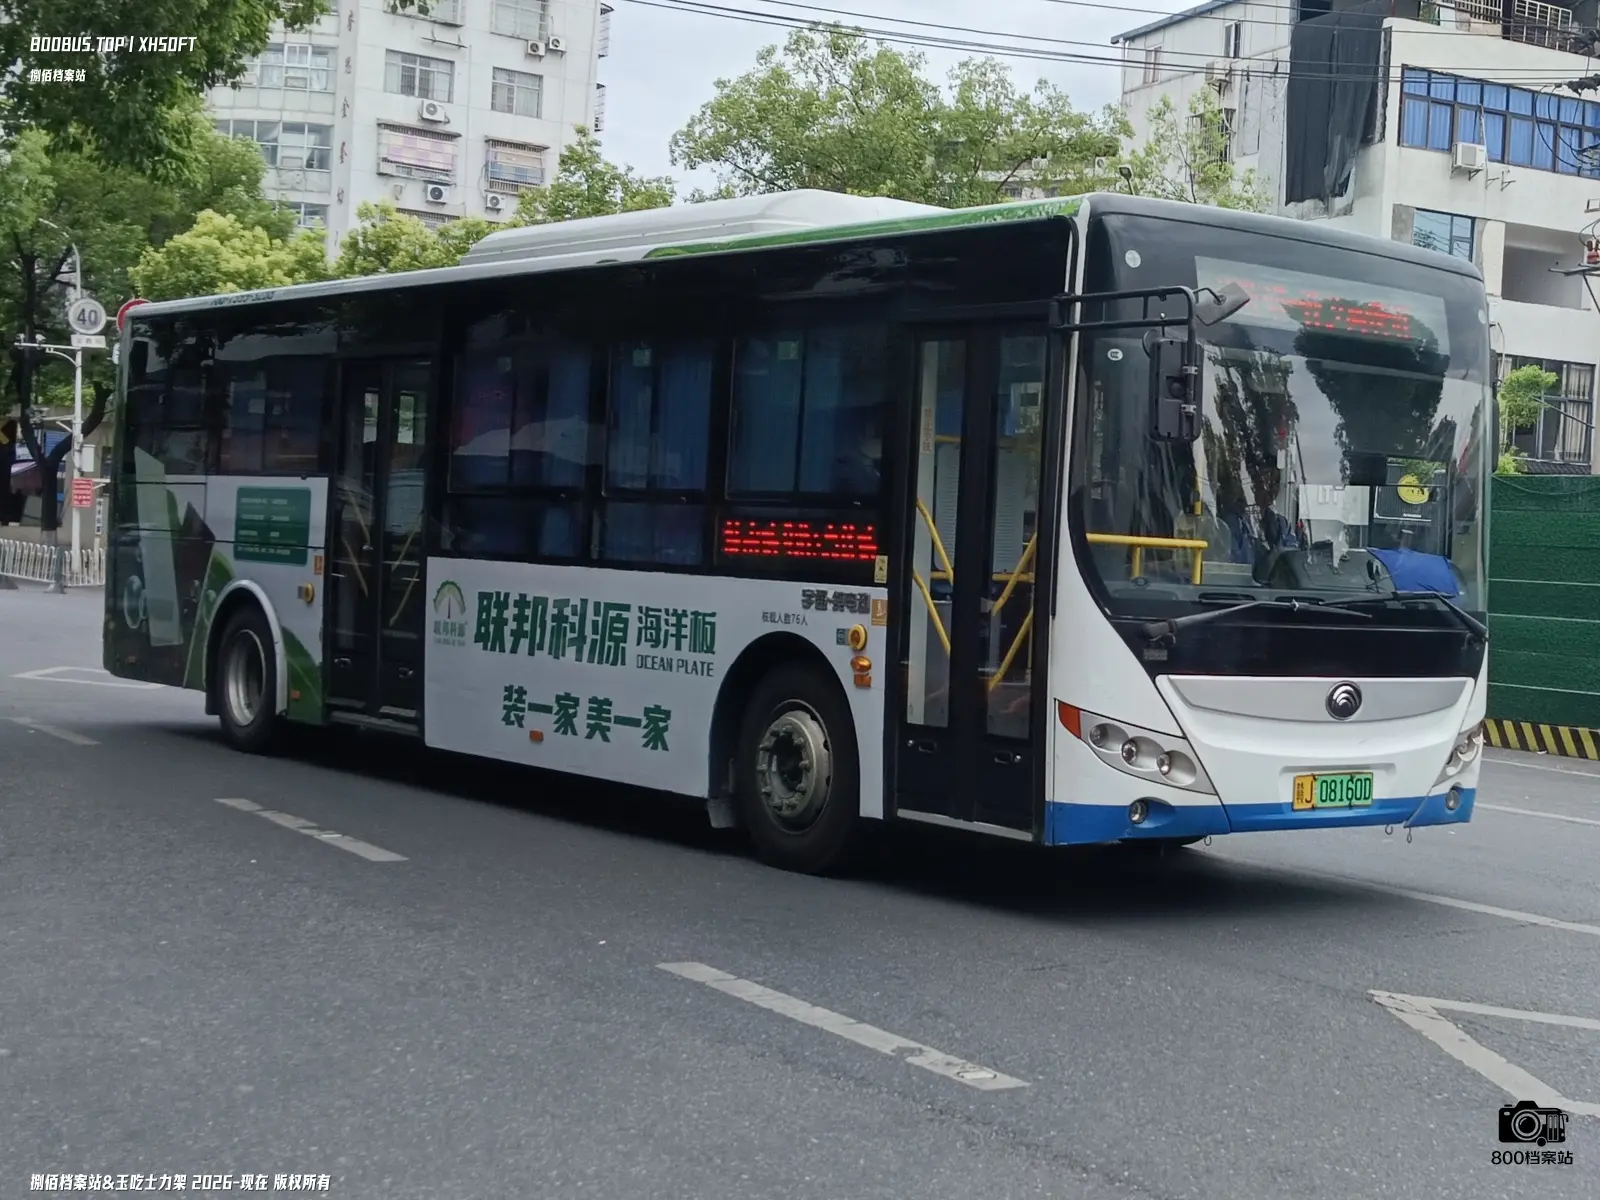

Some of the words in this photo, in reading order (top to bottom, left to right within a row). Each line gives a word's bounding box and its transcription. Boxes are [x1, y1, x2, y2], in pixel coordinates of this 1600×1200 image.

[76, 308, 98, 326] 40
[474, 590, 632, 667] 联邦科源
[636, 605, 718, 655] 海洋板
[636, 654, 674, 672] OCEAN
[676, 659, 715, 677] PLATE
[502, 684, 672, 752] 装一家美一家
[1320, 777, 1371, 802] 08160D
